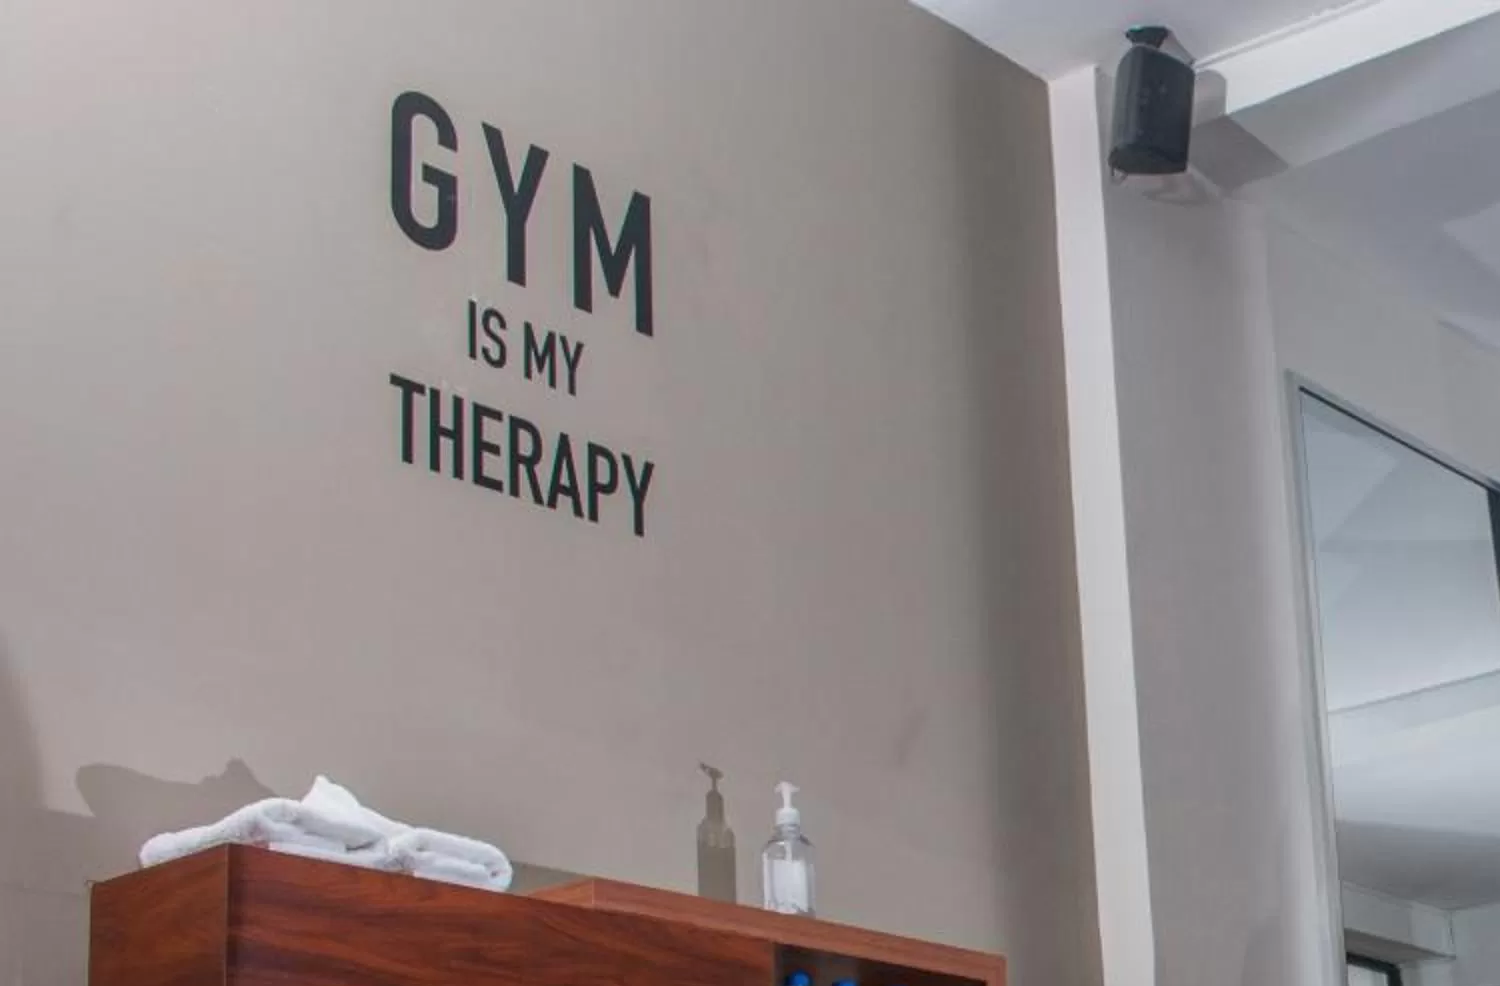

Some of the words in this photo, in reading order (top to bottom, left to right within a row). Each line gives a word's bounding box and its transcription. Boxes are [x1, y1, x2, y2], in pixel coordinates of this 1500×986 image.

[391, 91, 653, 337] GYM
[468, 299, 507, 369] IS
[523, 321, 584, 396] MY
[389, 373, 655, 537] THERAPY
